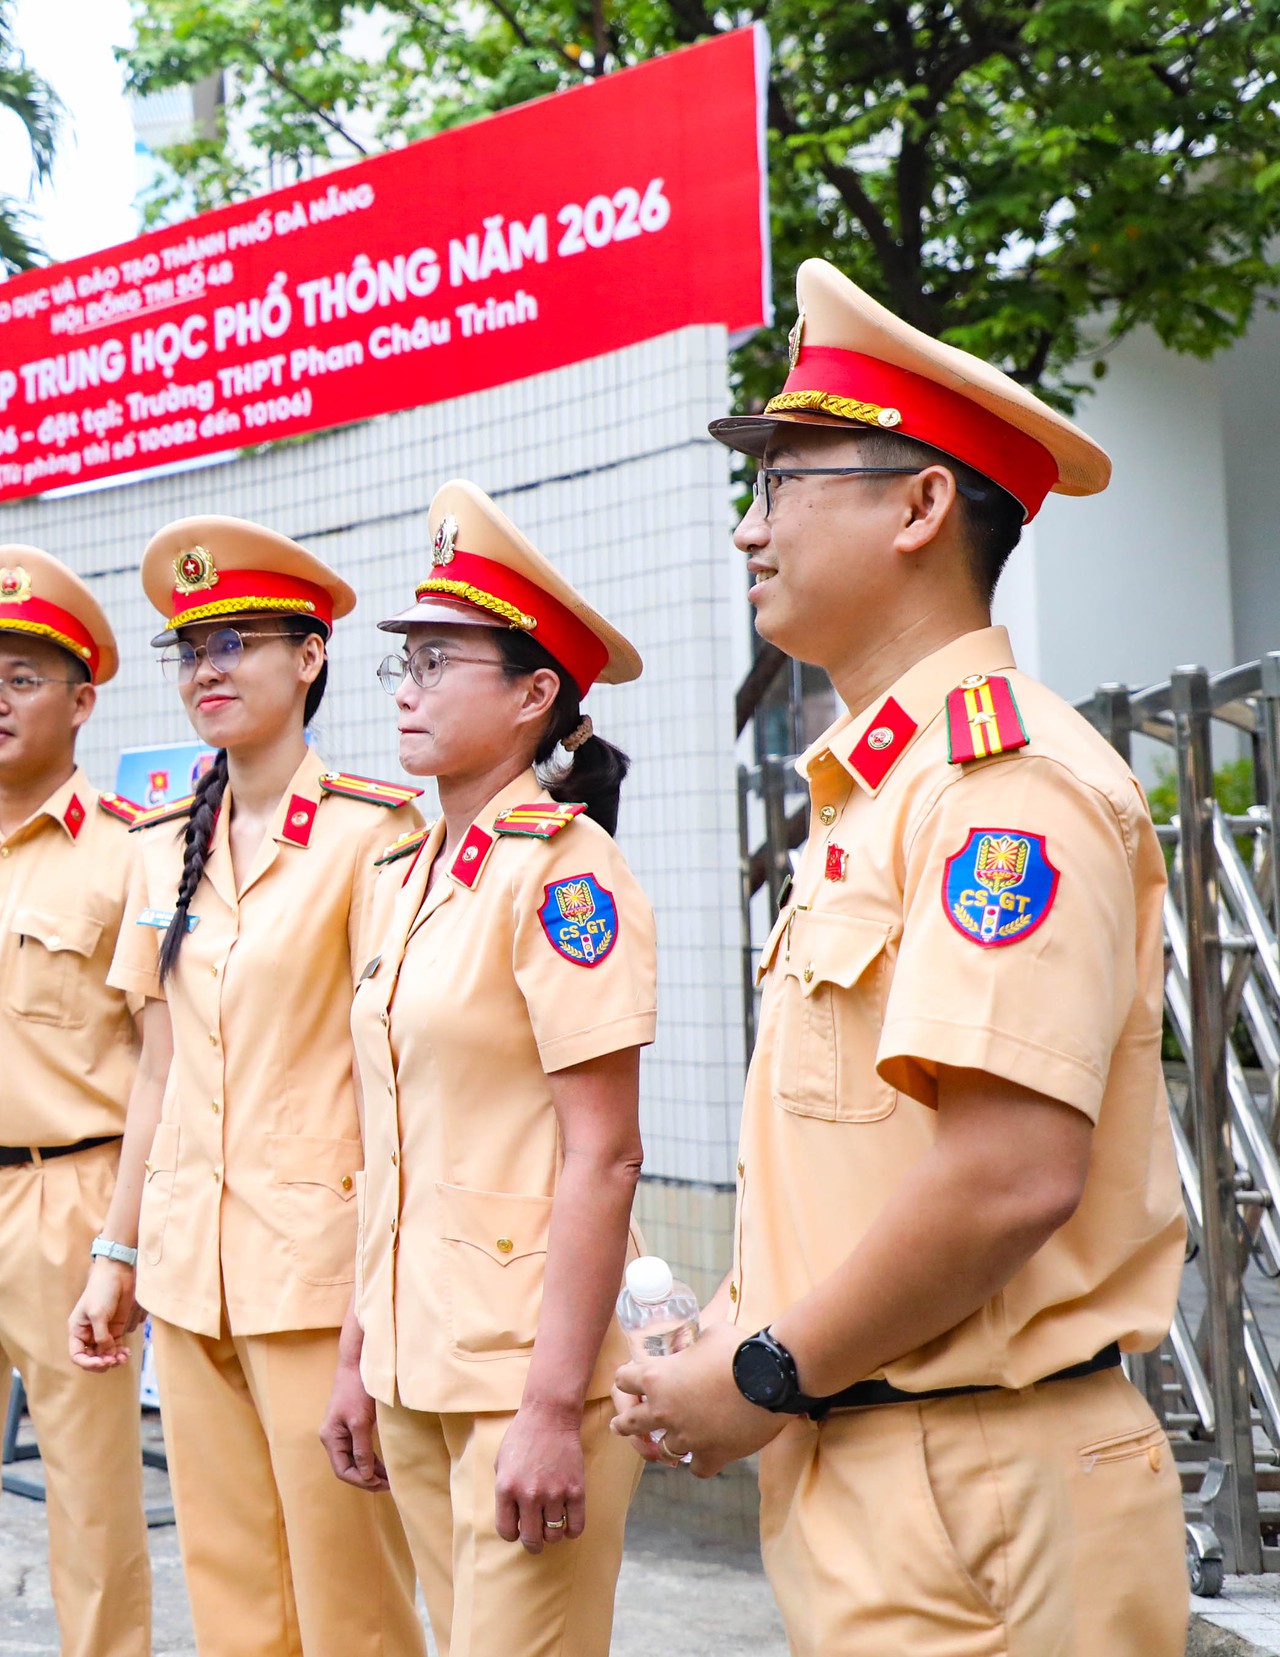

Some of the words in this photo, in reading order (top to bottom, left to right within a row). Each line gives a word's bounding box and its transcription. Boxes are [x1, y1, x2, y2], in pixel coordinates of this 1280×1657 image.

[12, 288, 50, 318] DỤC
[50, 276, 76, 305] VÀ
[77, 266, 120, 298] ĐÀO
[121, 253, 160, 286] TẠO
[160, 230, 227, 270] THÀNH
[227, 208, 273, 251] PHỐ
[274, 200, 308, 236] ĐÀ
[309, 183, 375, 225] NẴNG
[21, 338, 123, 404] TRUNG
[131, 314, 207, 379] HỌC
[213, 270, 292, 352] PHỔ
[296, 246, 441, 328] THÔNG
[449, 214, 548, 288] NĂM
[557, 177, 671, 257] 2026
[51, 304, 84, 336] HỘI
[85, 289, 143, 323] ĐỒNG
[142, 277, 175, 306] THI
[175, 261, 206, 297] SỐ
[206, 260, 234, 287] 48
[37, 411, 80, 448] đặt
[81, 398, 124, 439] tại:
[125, 379, 214, 421] Trường
[217, 352, 287, 400] THPT
[289, 336, 363, 382] Phan
[368, 316, 451, 360] Châu
[456, 289, 538, 338] Trinh
[22, 452, 81, 486] phòng
[82, 440, 111, 467] thi
[111, 431, 137, 461] số
[199, 407, 241, 439] đến
